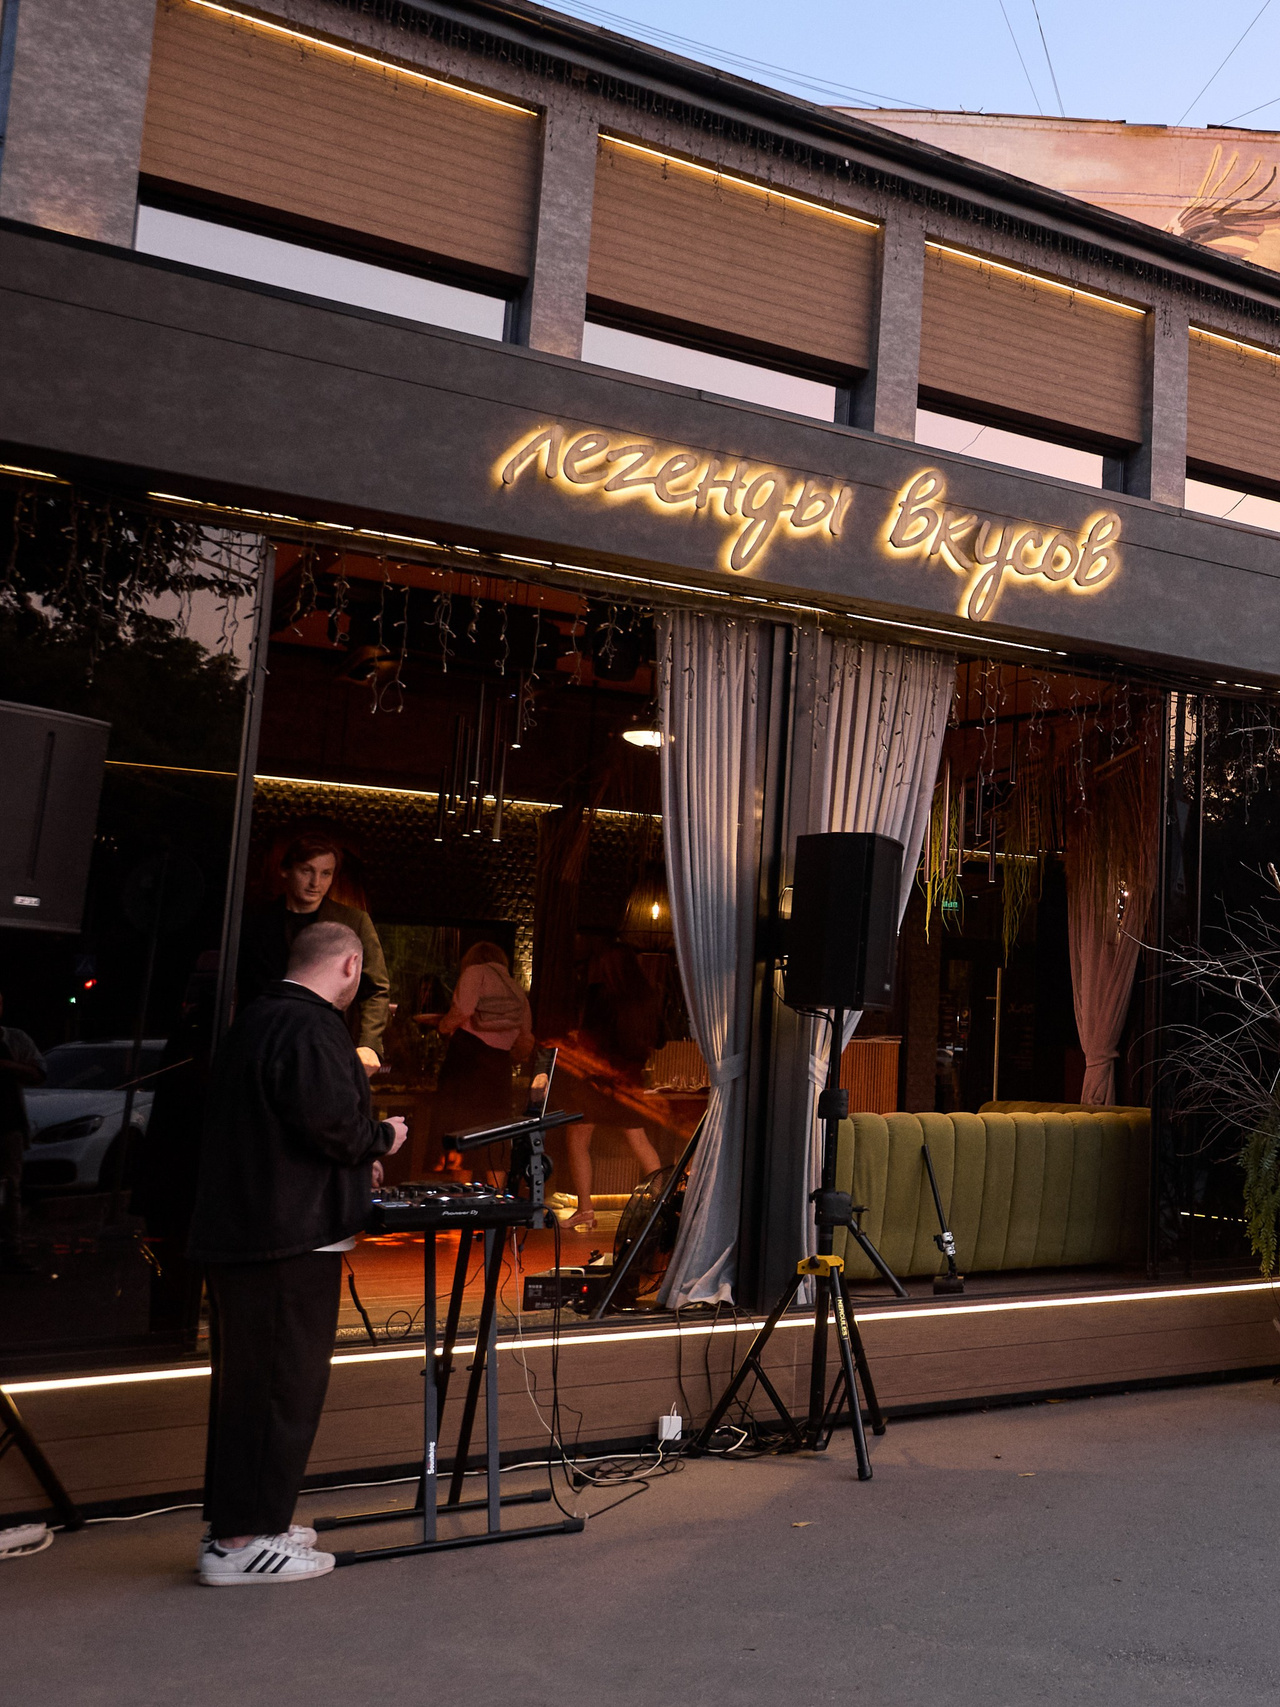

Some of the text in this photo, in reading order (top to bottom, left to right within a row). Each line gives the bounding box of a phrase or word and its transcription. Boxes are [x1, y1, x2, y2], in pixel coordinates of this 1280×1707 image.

[501, 423, 1122, 622] легенды вкусов
[837, 1299, 847, 1336] HERCULES
